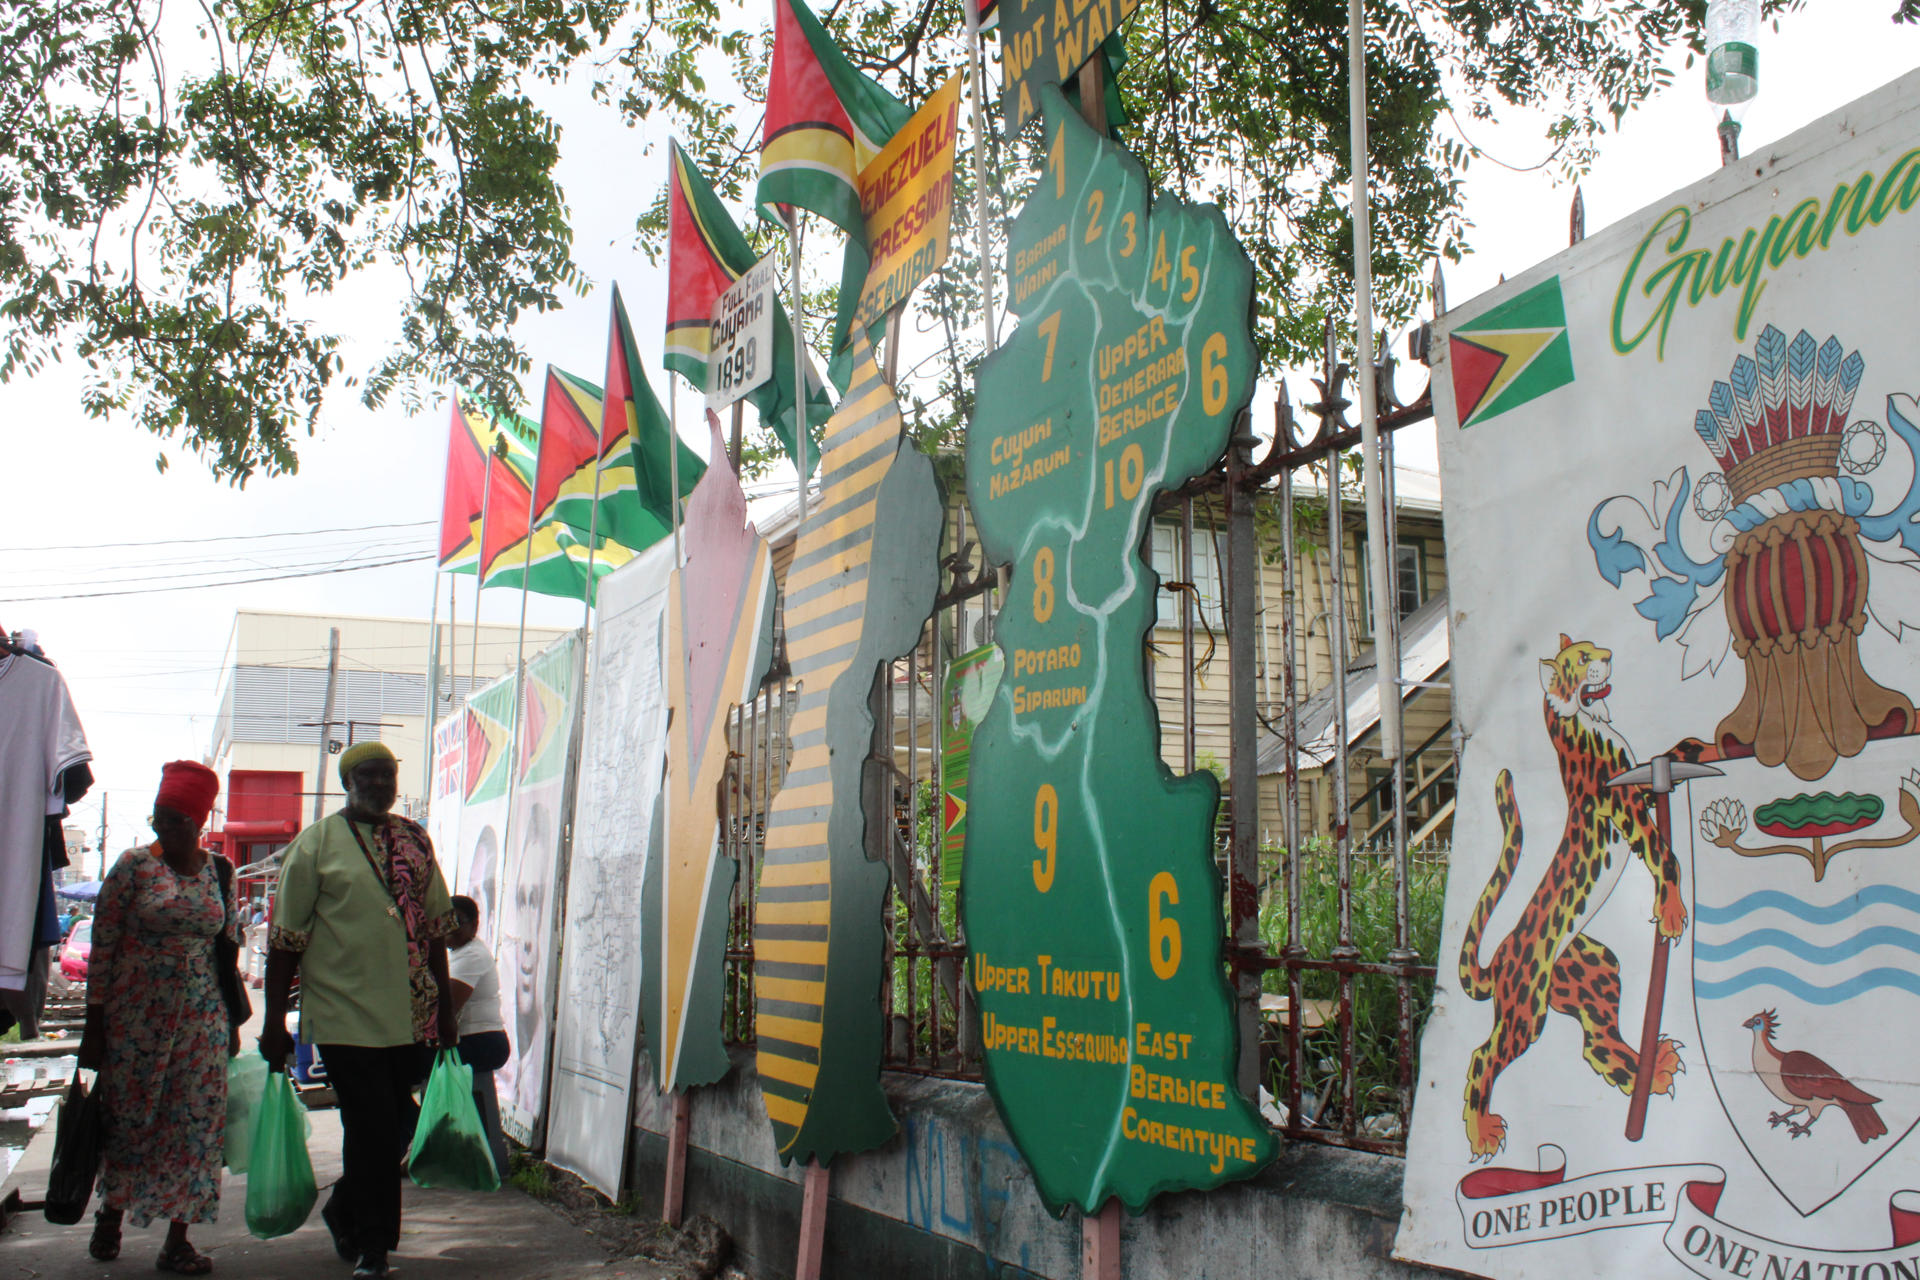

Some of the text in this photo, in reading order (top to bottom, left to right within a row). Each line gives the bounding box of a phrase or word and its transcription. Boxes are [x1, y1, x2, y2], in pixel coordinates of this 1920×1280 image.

[1003, 14, 1045, 91] NOT
[1018, 80, 1034, 127] A
[1049, 119, 1065, 199] 1
[1085, 189, 1104, 244] 2
[1119, 211, 1137, 257] 3
[1015, 259, 1057, 304] WAINI
[1150, 230, 1171, 291] 4
[1180, 245, 1199, 303] 5
[1610, 147, 1920, 363] Guyana
[717, 336, 757, 391] 1899
[1038, 310, 1062, 383] 7
[1099, 315, 1168, 380] UPPER
[1201, 331, 1229, 417] 6
[1100, 346, 1185, 413] DEMERARA
[1104, 443, 1144, 510] 10
[1032, 546, 1055, 623] 8
[1013, 643, 1081, 678] POTARO
[1032, 783, 1058, 893] 9
[1149, 871, 1182, 980] 6
[975, 952, 1120, 1002] UPPER TAKUTU
[983, 1011, 1040, 1056] UPPER
[1136, 1023, 1193, 1061] EAST
[1472, 1181, 1666, 1239] ONE PEOPLE
[1683, 1224, 1760, 1279] ONE
